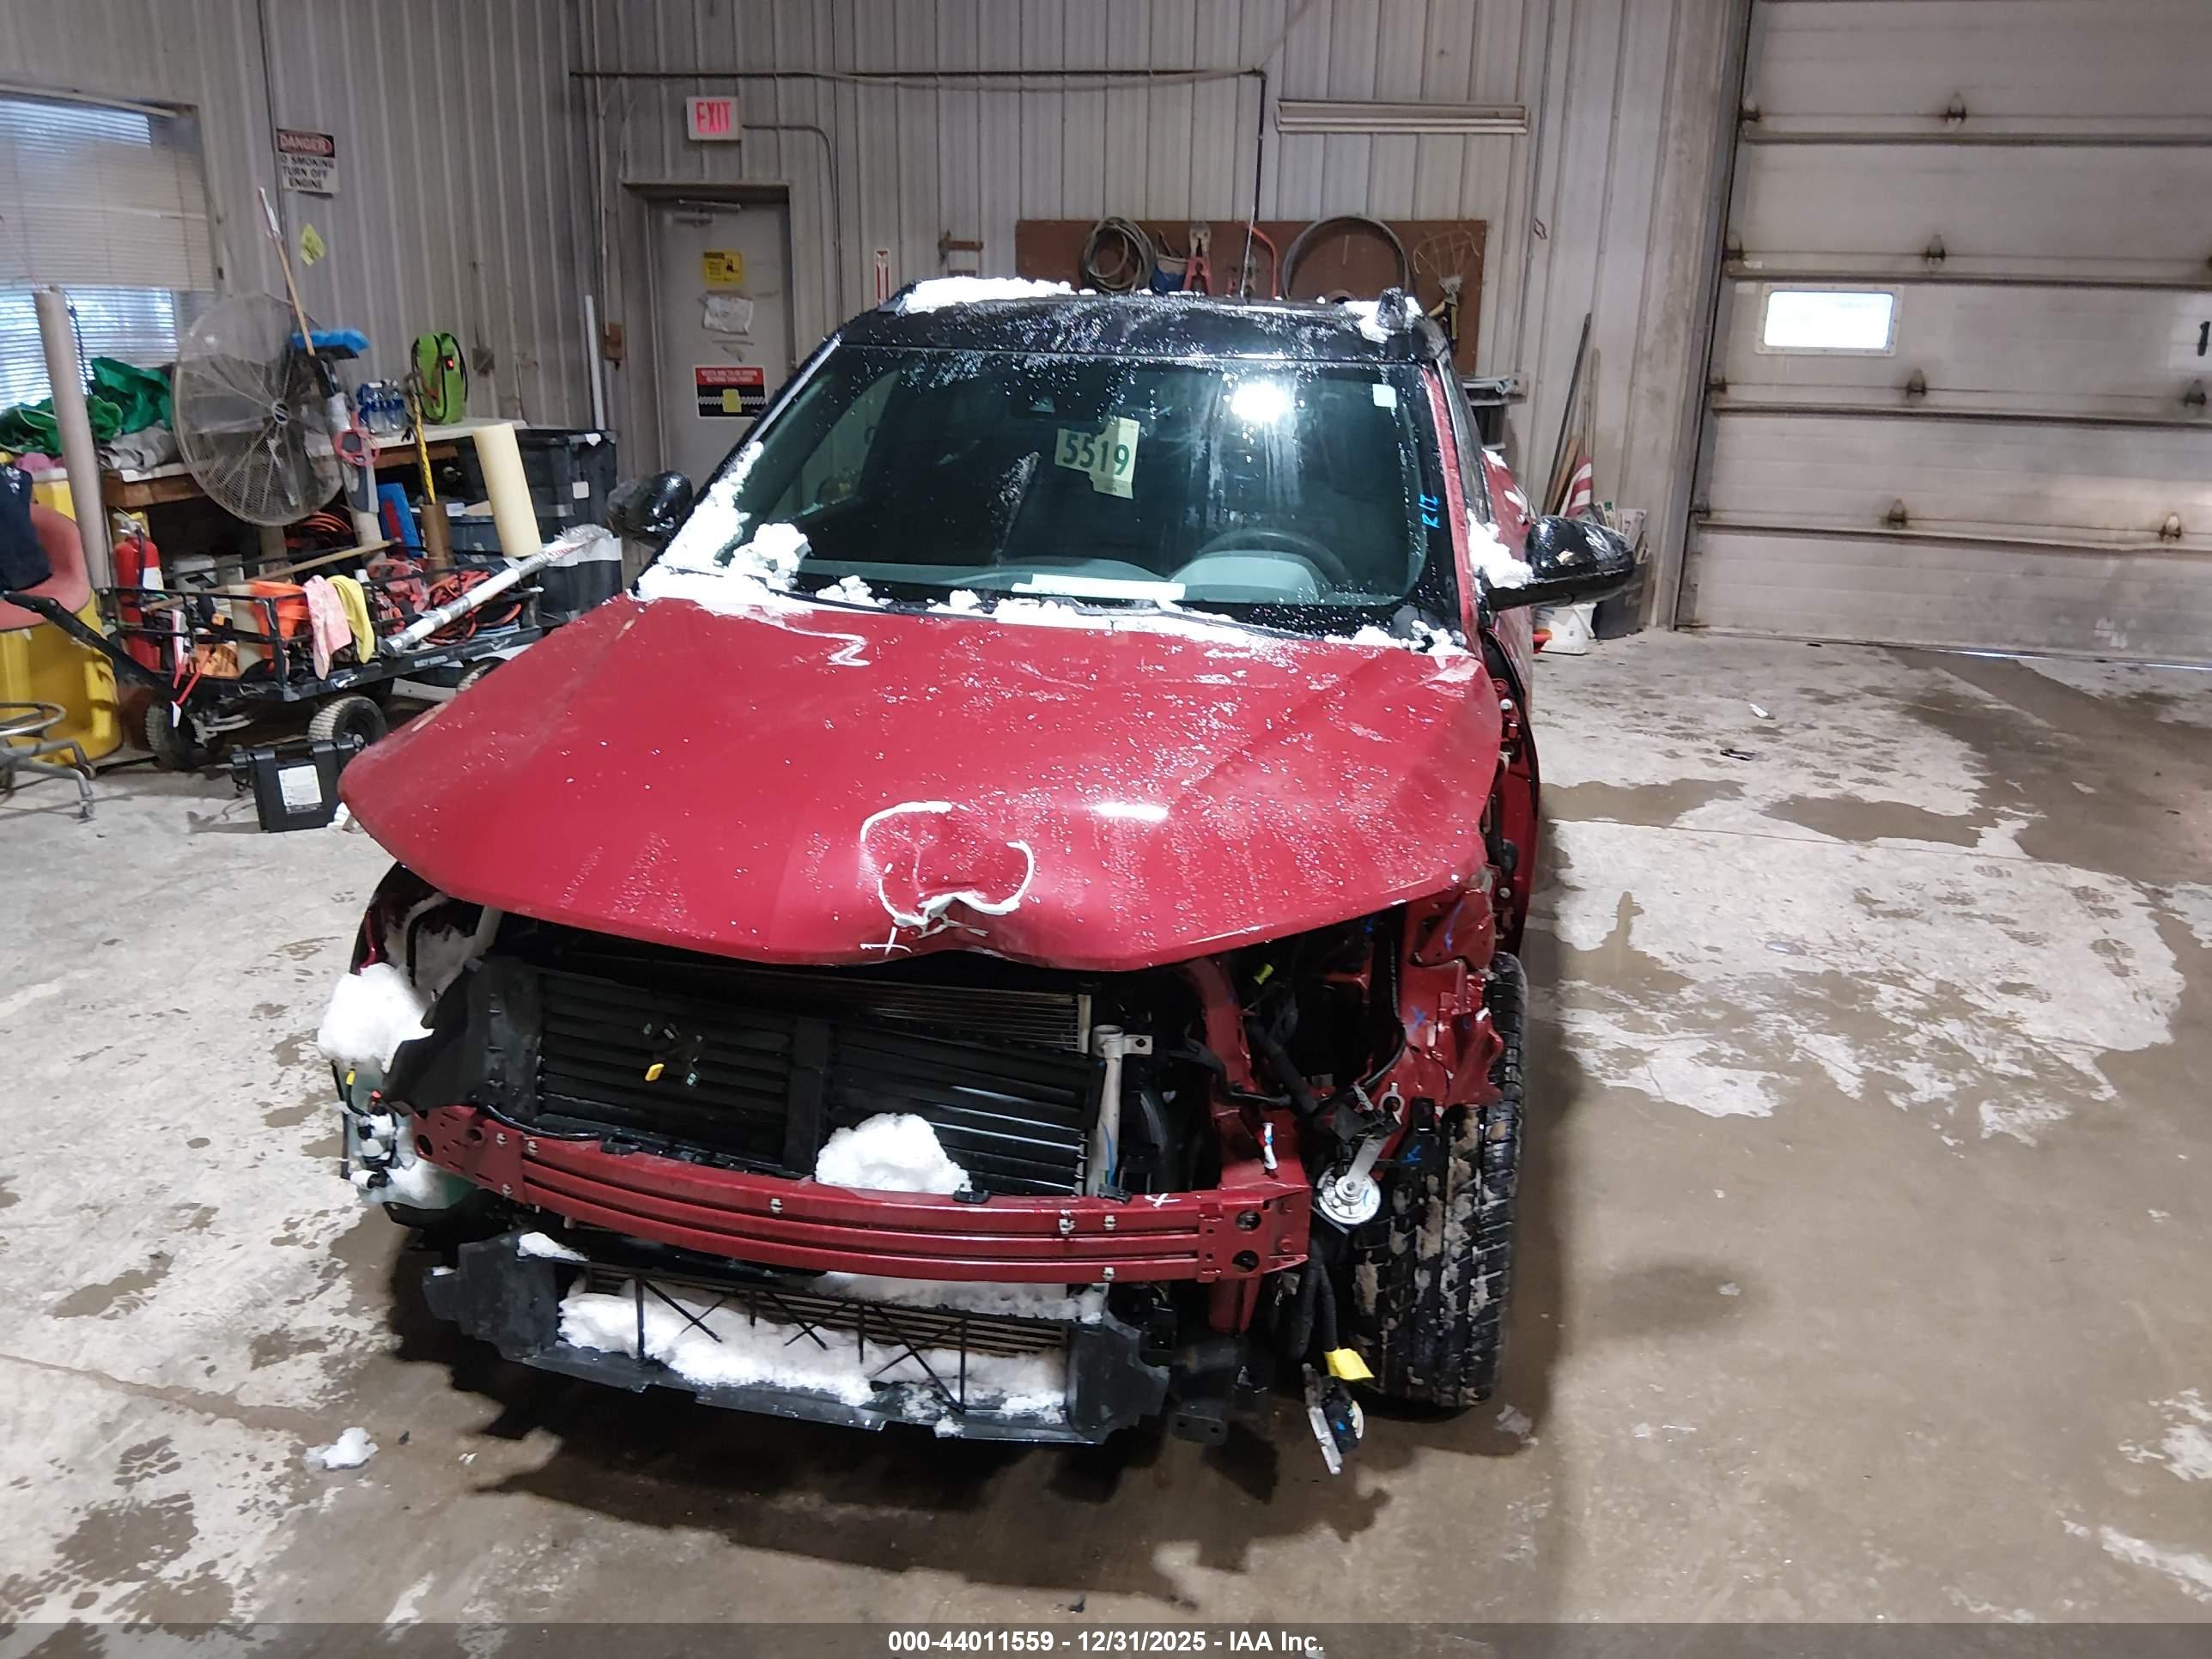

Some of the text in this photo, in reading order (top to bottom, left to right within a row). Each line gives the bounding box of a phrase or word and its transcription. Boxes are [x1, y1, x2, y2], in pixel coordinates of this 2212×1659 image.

[696, 101, 730, 133] EXIT
[279, 133, 328, 153] DANGER
[291, 155, 335, 169] SMOKING
[283, 166, 328, 179] TURN OFF
[289, 177, 324, 190] ENGINE
[1062, 433, 1130, 476] 5519
